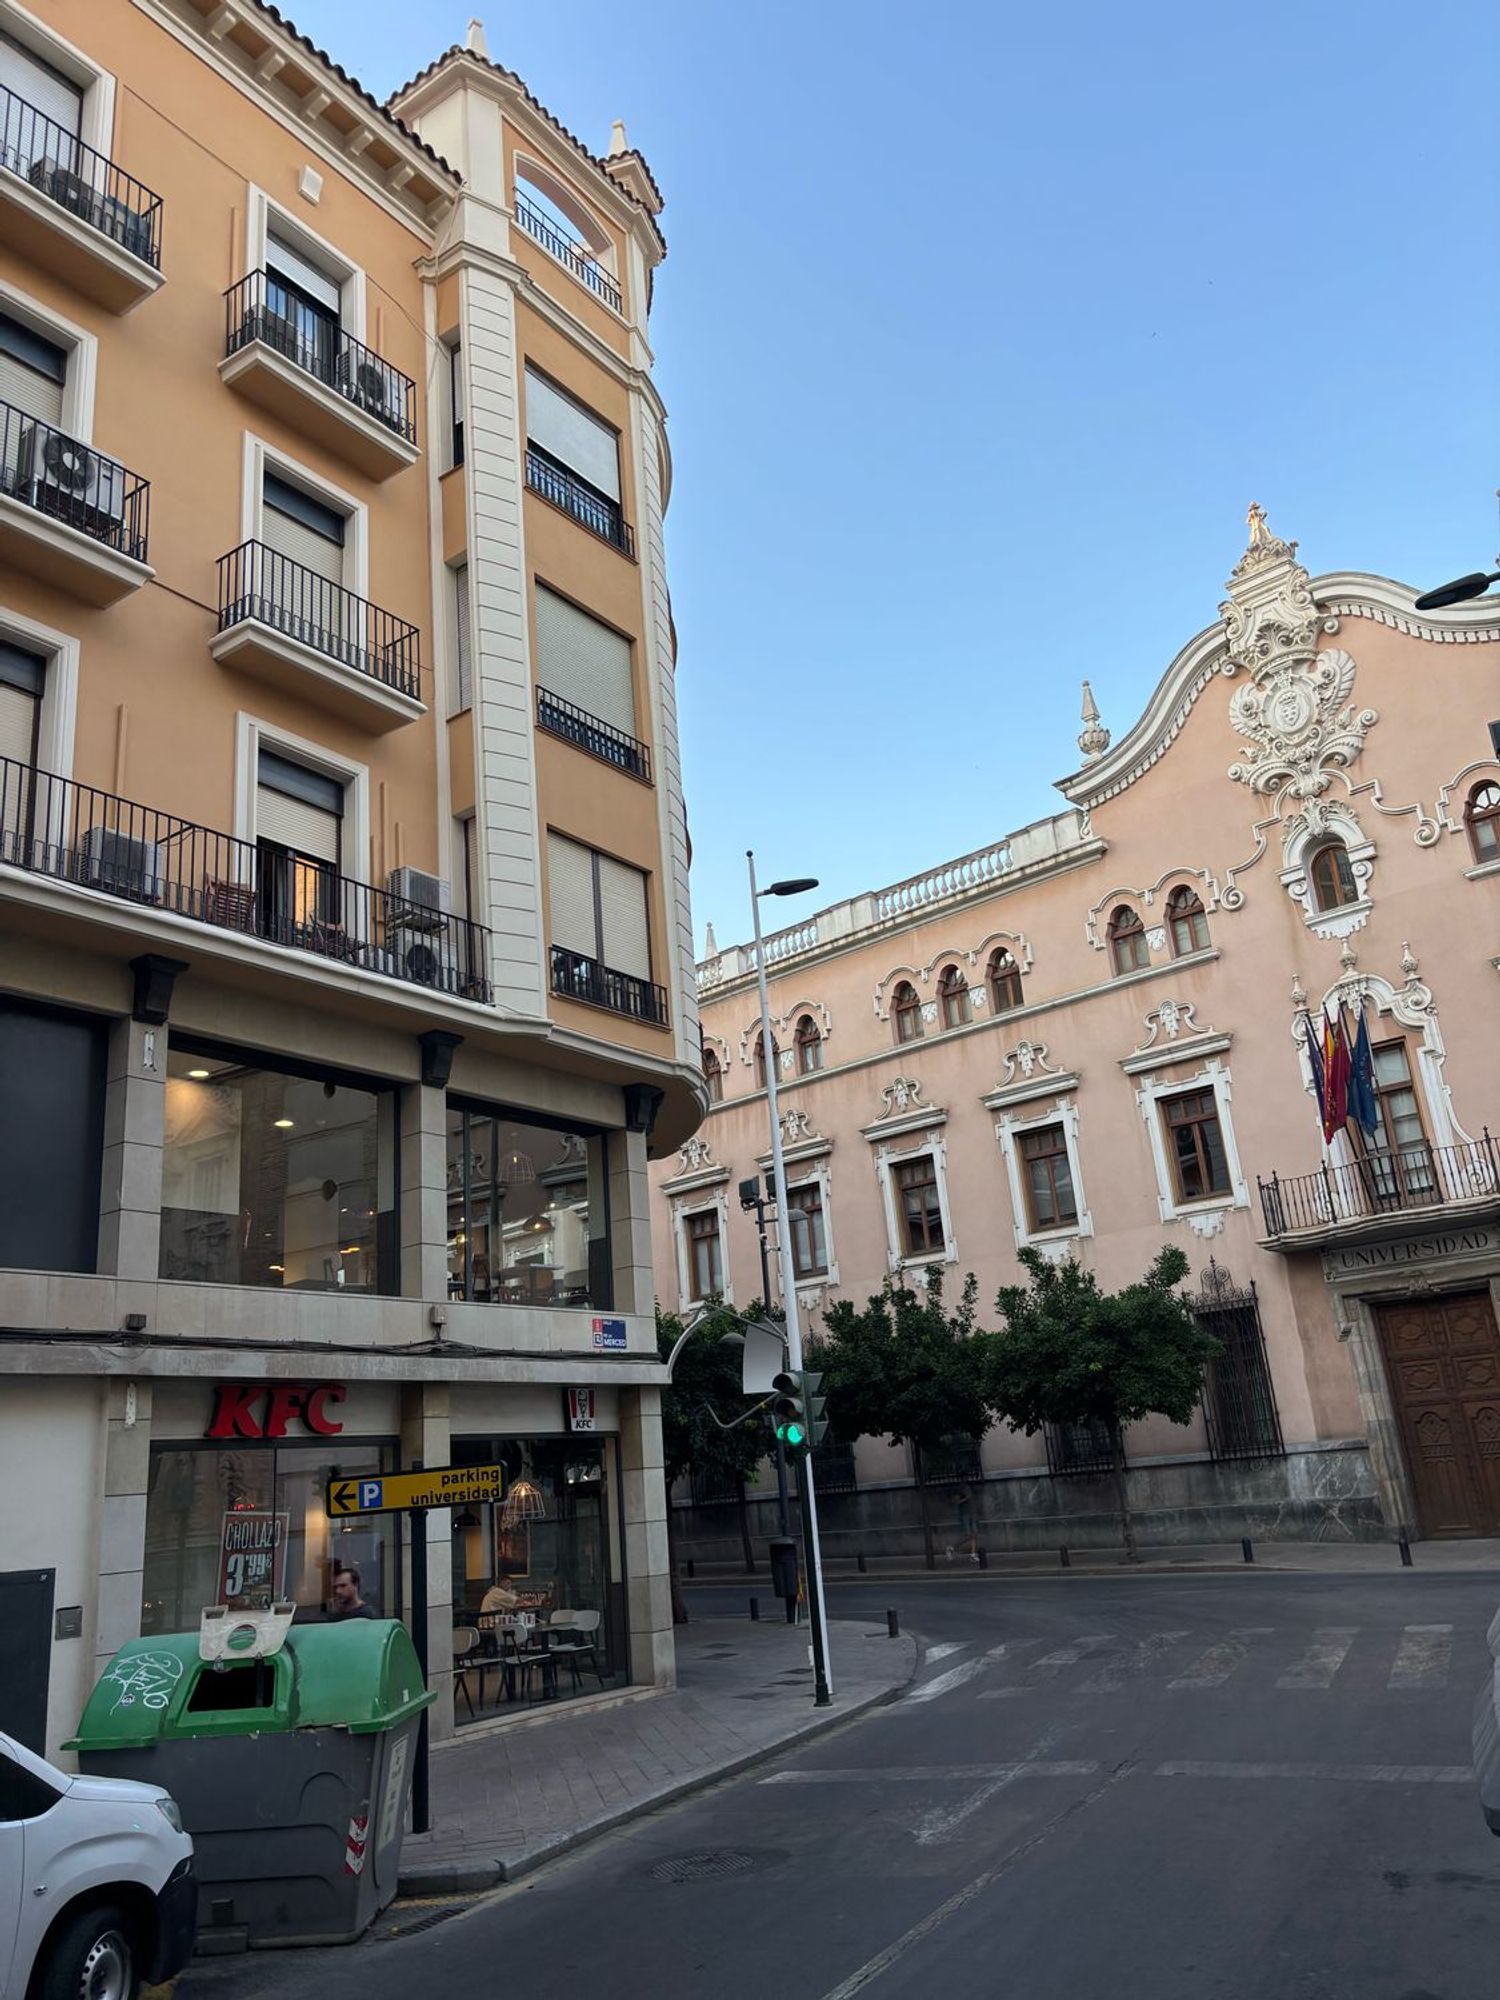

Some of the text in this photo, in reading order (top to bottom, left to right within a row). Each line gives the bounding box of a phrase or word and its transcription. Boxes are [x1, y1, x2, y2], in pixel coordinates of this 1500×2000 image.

[1341, 1231, 1489, 1268] UNIVERSIDAD
[206, 1384, 348, 1438] KFC
[575, 1420, 592, 1428] KFC
[441, 1468, 500, 1487] parking
[363, 1483, 380, 1507] P
[410, 1485, 500, 1506] universidad
[225, 1519, 281, 1551] CHOLLAZO
